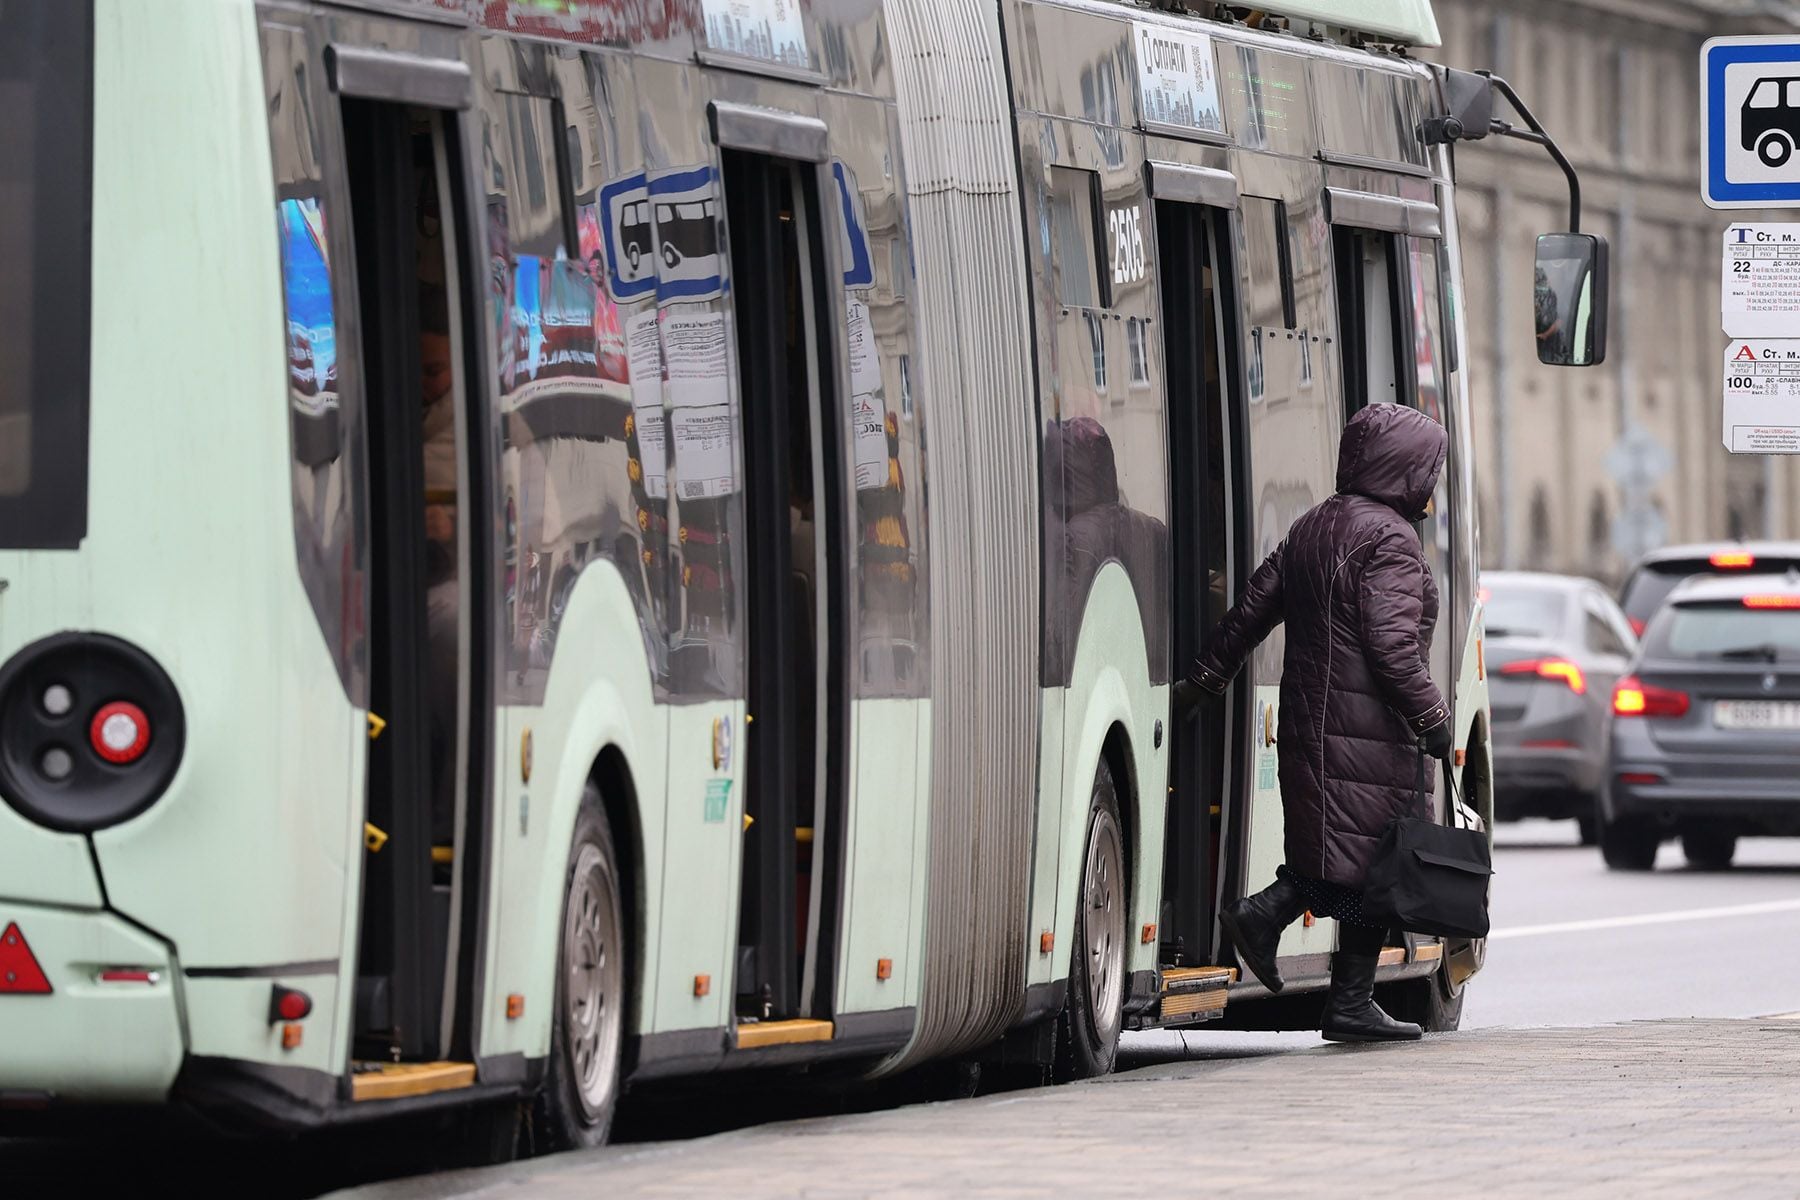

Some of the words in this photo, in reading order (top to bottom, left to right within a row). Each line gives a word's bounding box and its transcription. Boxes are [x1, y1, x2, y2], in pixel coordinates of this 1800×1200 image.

[1756, 231, 1776, 242] Ст.
[1783, 234, 1797, 242] м.
[1110, 206, 1144, 283] 2505
[1733, 261, 1751, 272] 22
[1734, 345, 1757, 360] А
[1763, 349, 1781, 359] Ст.
[1727, 377, 1752, 388] 100
